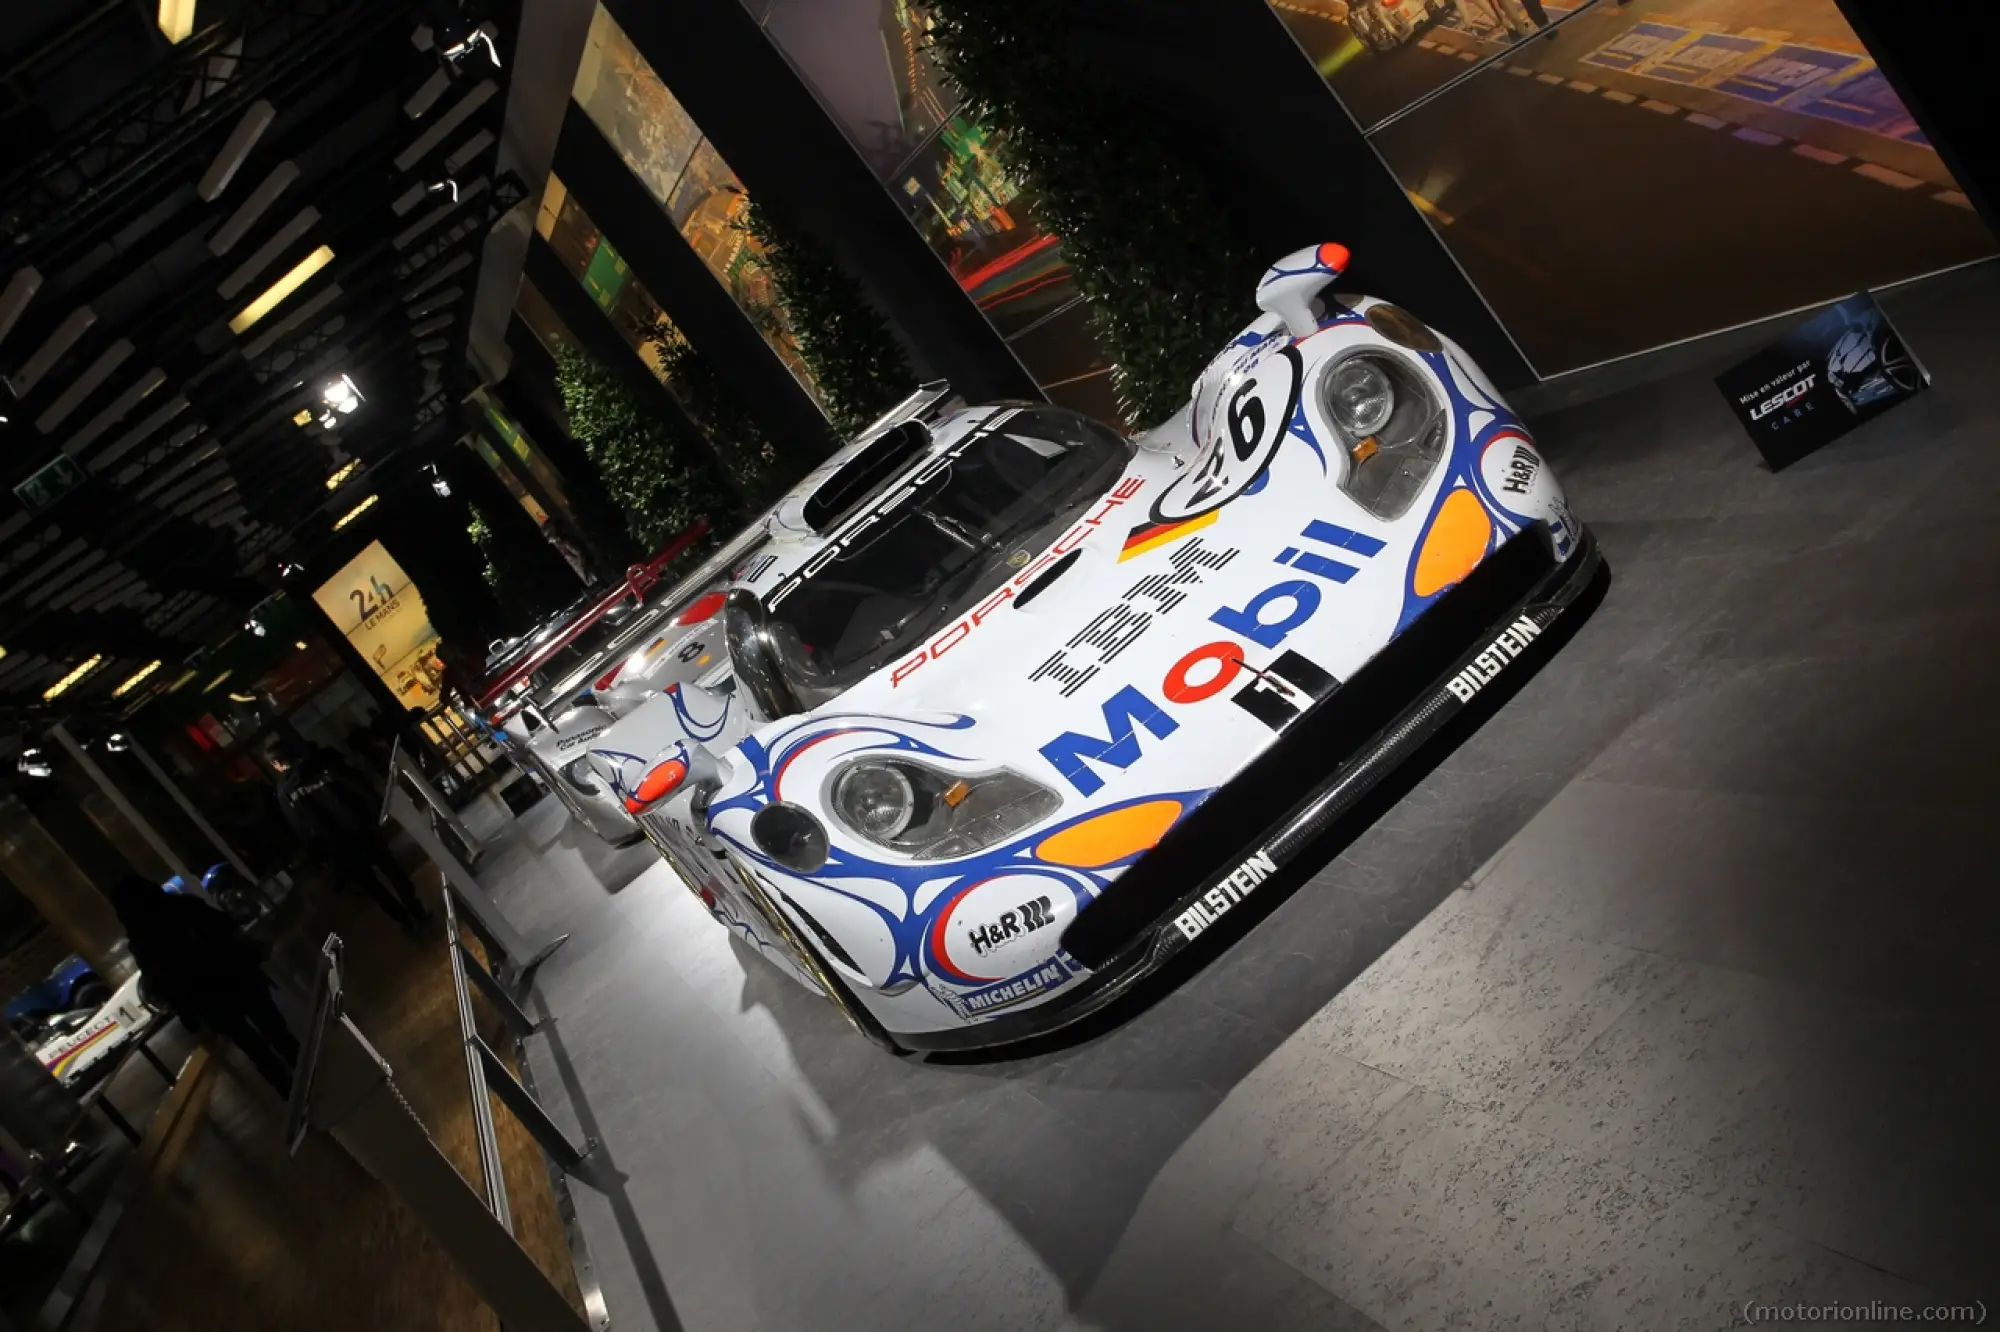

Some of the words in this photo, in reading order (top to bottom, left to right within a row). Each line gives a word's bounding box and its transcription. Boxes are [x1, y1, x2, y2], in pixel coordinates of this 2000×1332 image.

[1750, 374, 1816, 421] LESCOT
[768, 408, 1025, 613] PORSCHE
[364, 617, 377, 630] LE
[378, 600, 401, 619] MANS
[890, 477, 1146, 688] PORSCHE
[1028, 537, 1240, 698] IBM
[677, 641, 706, 663] 8
[1038, 519, 1388, 798] Mobil
[1448, 614, 1542, 704] BILSTEIN
[1174, 848, 1278, 942] BILSTEIN
[967, 964, 1061, 1012] MICHELIN
